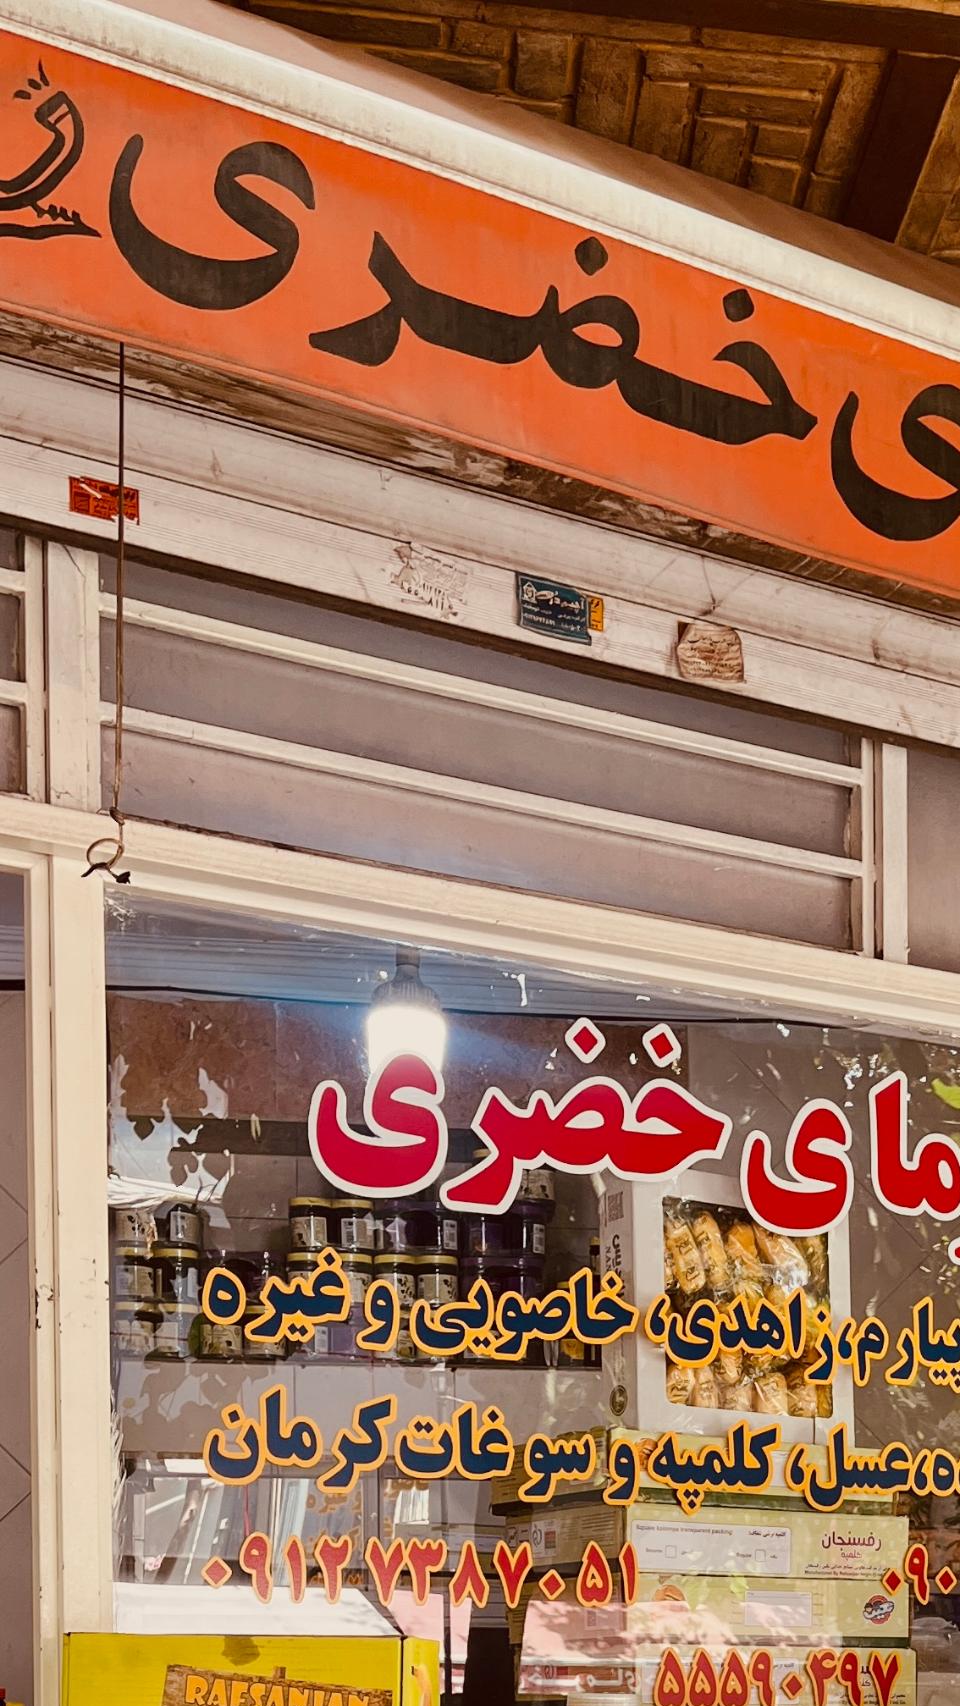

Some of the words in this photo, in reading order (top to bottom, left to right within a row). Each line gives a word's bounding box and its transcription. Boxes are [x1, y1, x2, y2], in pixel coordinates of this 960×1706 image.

[109, 133, 818, 445] خضری
[307, 1017, 731, 1217] خضری
[201, 1247, 352, 1343] غیره
[357, 1279, 402, 1352] و
[410, 1267, 640, 1360] خاصویی
[202, 1384, 398, 1494] کرمان
[607, 1430, 641, 1507] و
[647, 1421, 783, 1516] کلمپه
[821, 1530, 882, 1551] رفسنجان
